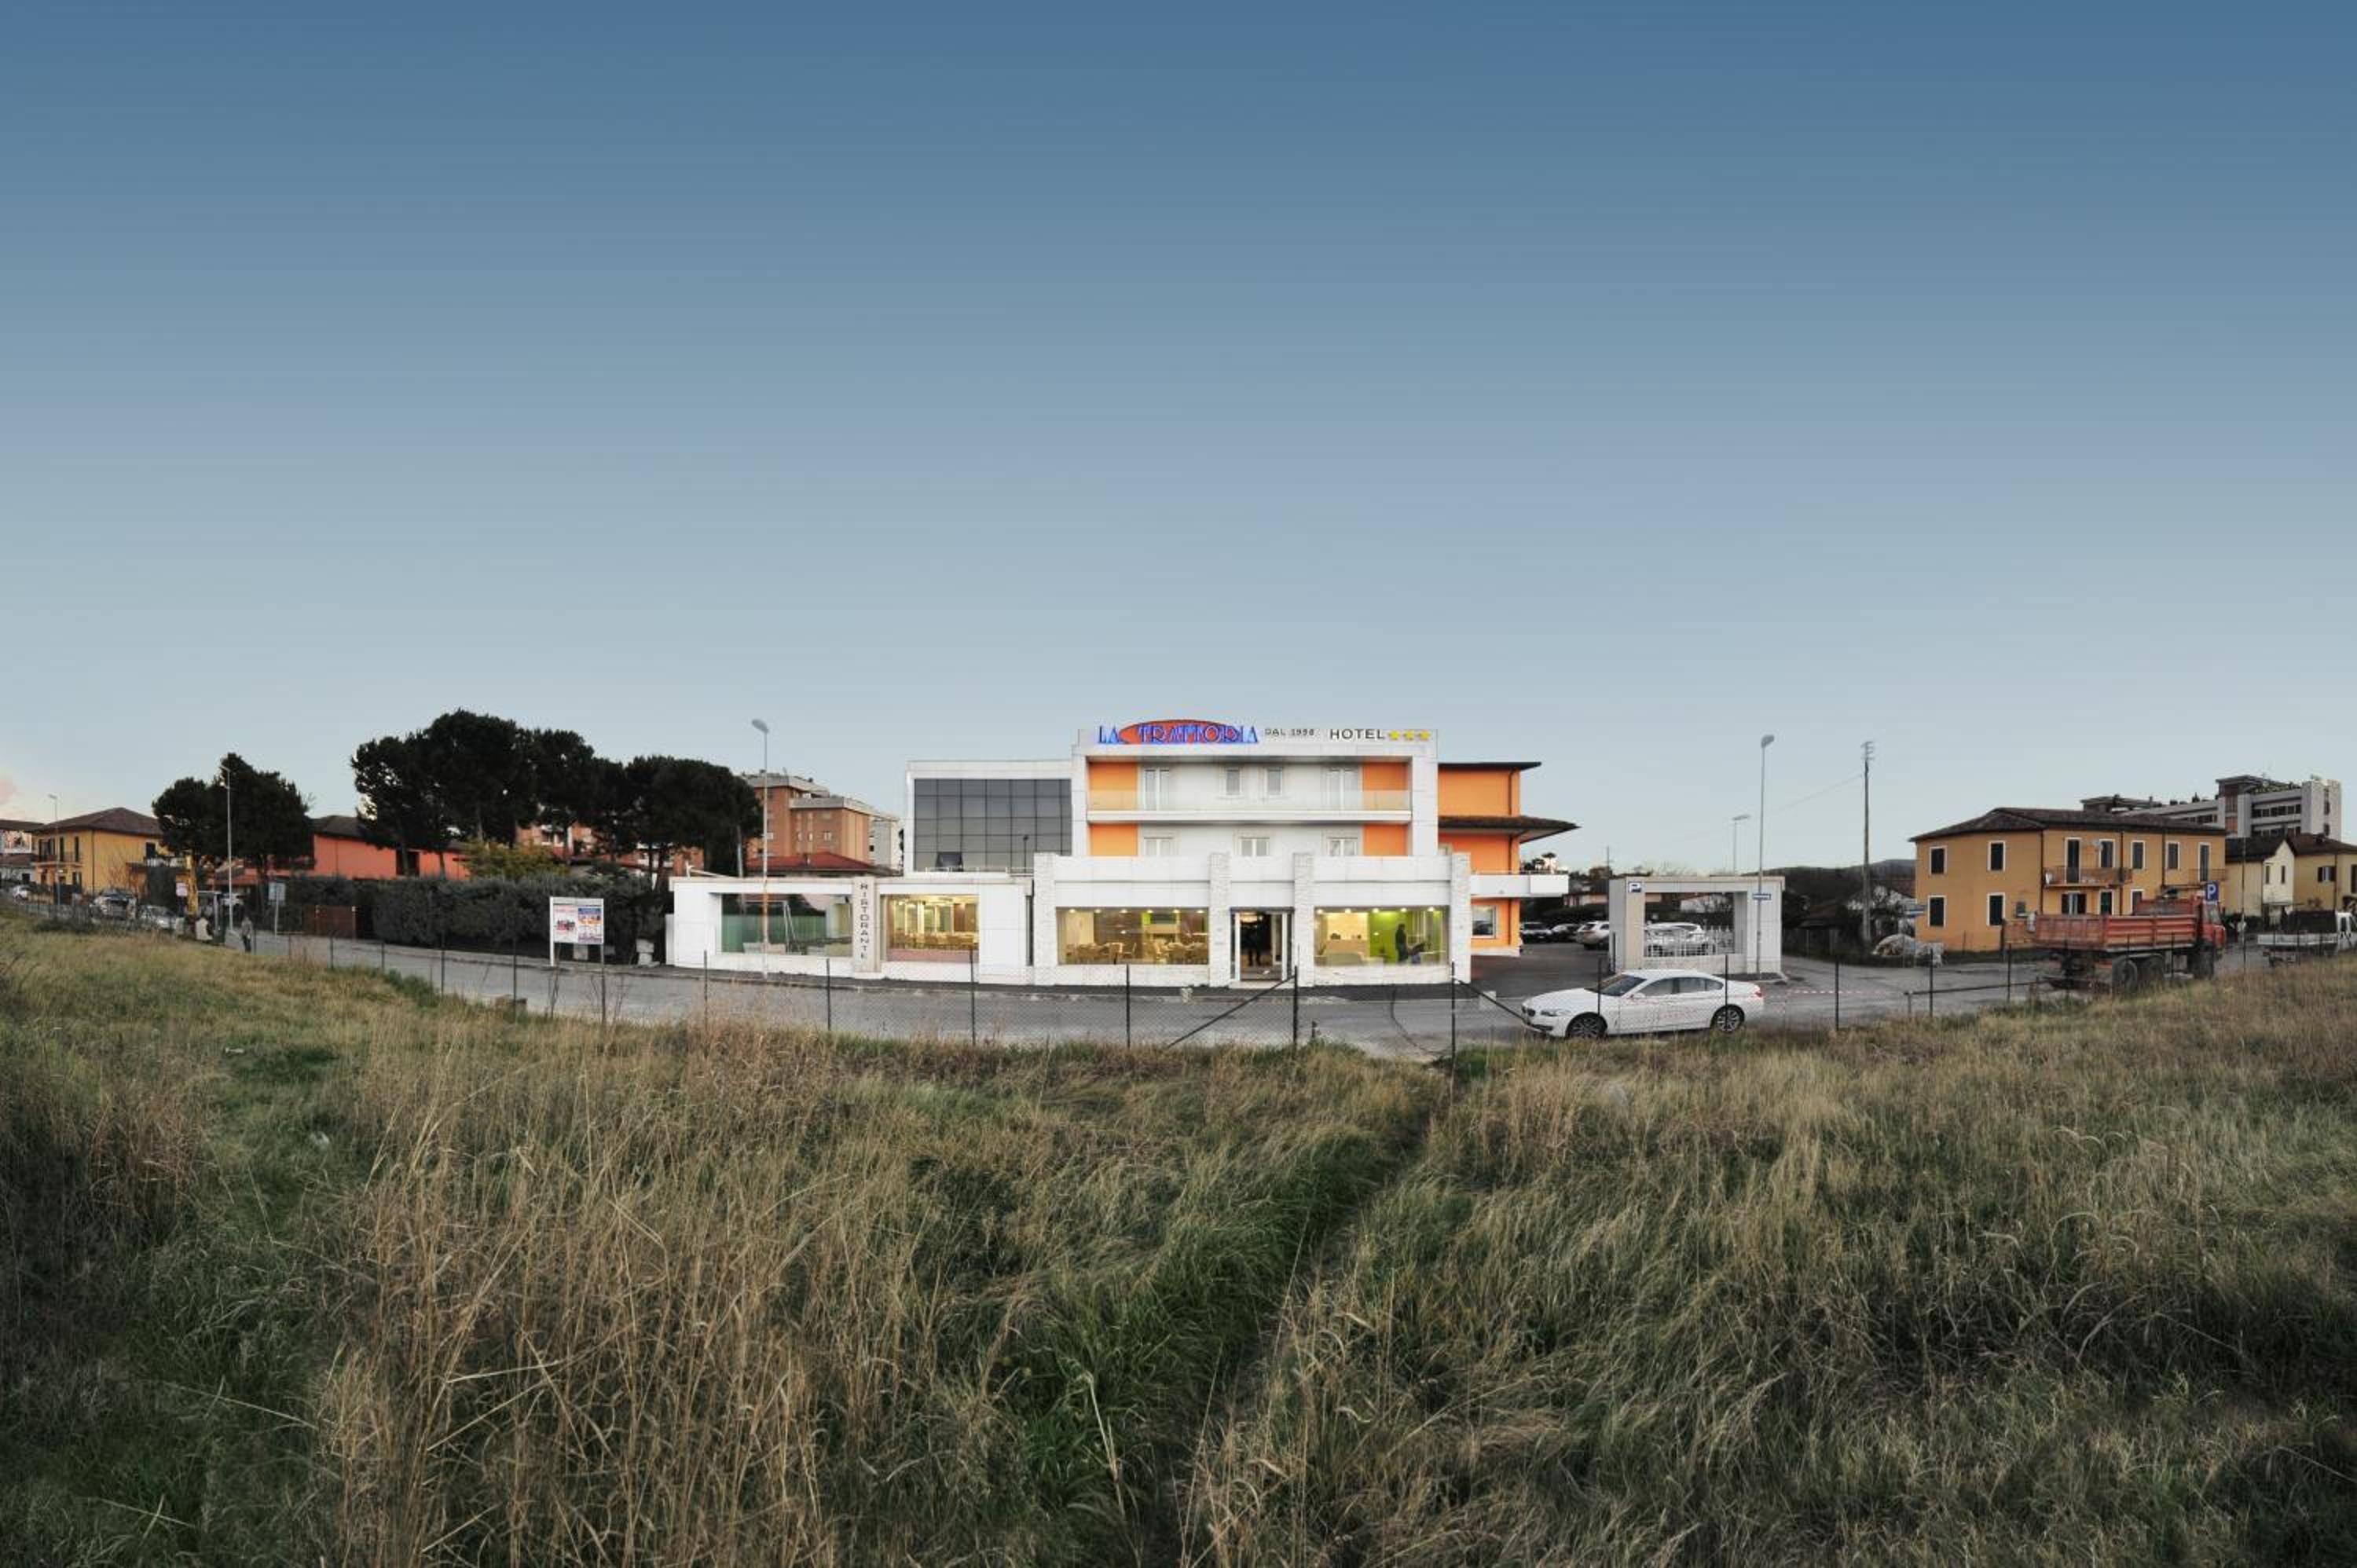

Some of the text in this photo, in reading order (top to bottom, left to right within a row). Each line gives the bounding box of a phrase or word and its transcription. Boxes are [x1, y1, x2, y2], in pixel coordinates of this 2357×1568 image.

[1098, 725, 1259, 744] LA TRATTORIA
[1329, 728, 1384, 739] HOTEL
[2208, 884, 2216, 899] P
